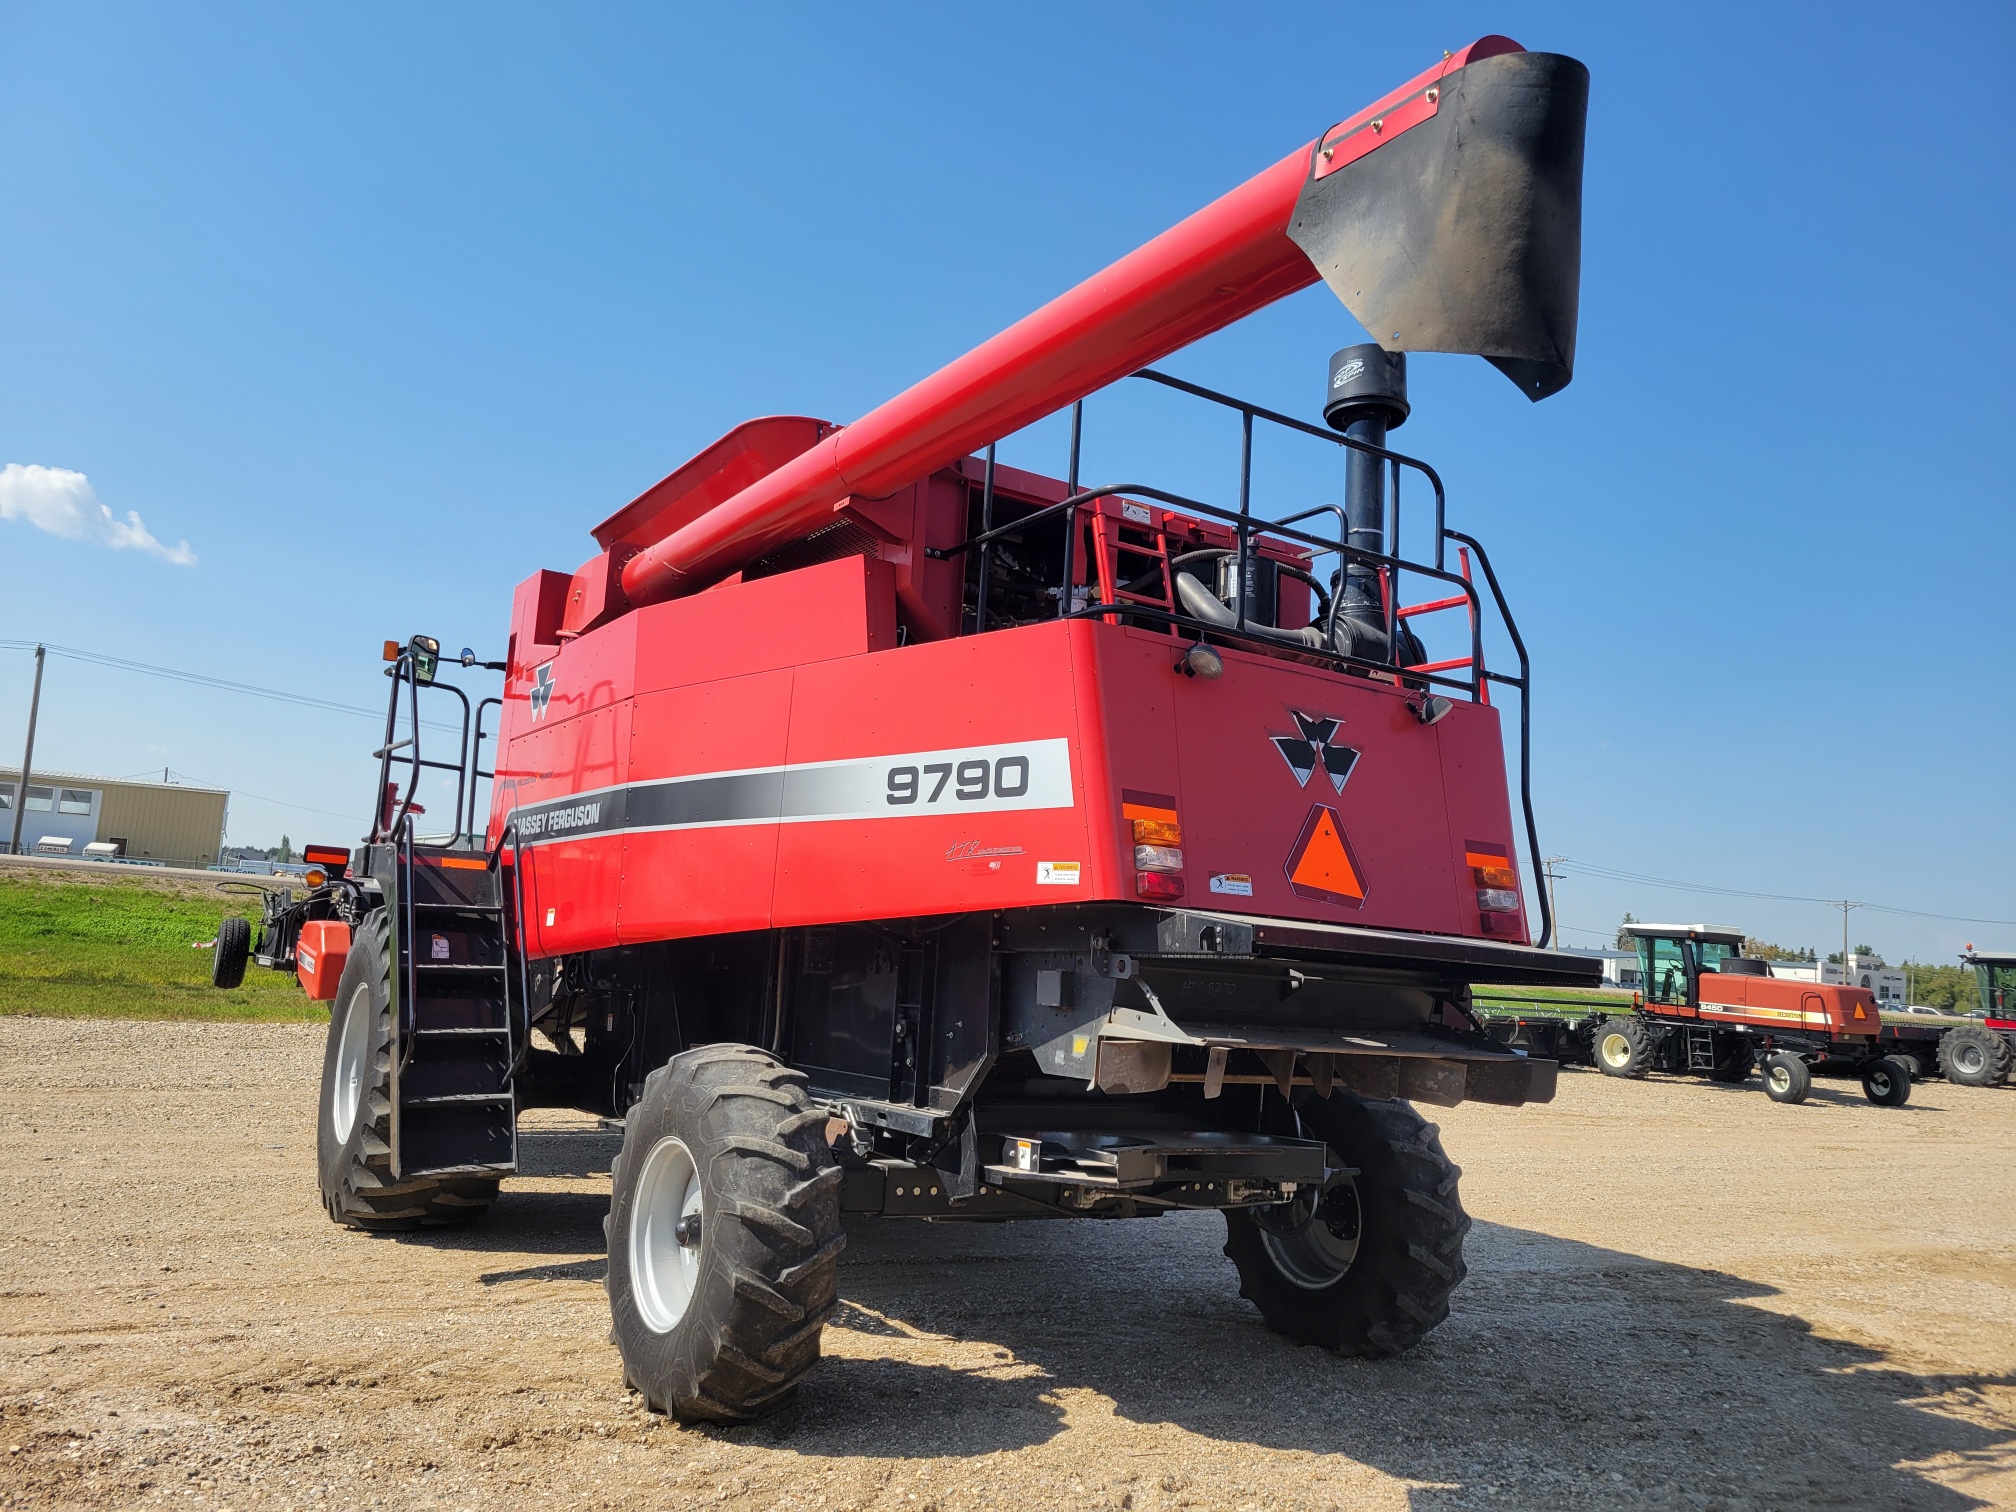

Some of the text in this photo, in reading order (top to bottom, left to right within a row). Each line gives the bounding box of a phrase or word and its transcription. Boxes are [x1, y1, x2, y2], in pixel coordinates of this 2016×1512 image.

[886, 755, 1029, 805] 9790
[548, 802, 601, 831] FERGUSON
[945, 839, 980, 859] ATR
[1857, 962, 1872, 970] South
[1700, 1003, 1723, 1012] 8450
[1777, 1011, 1802, 1019] HESSTON
